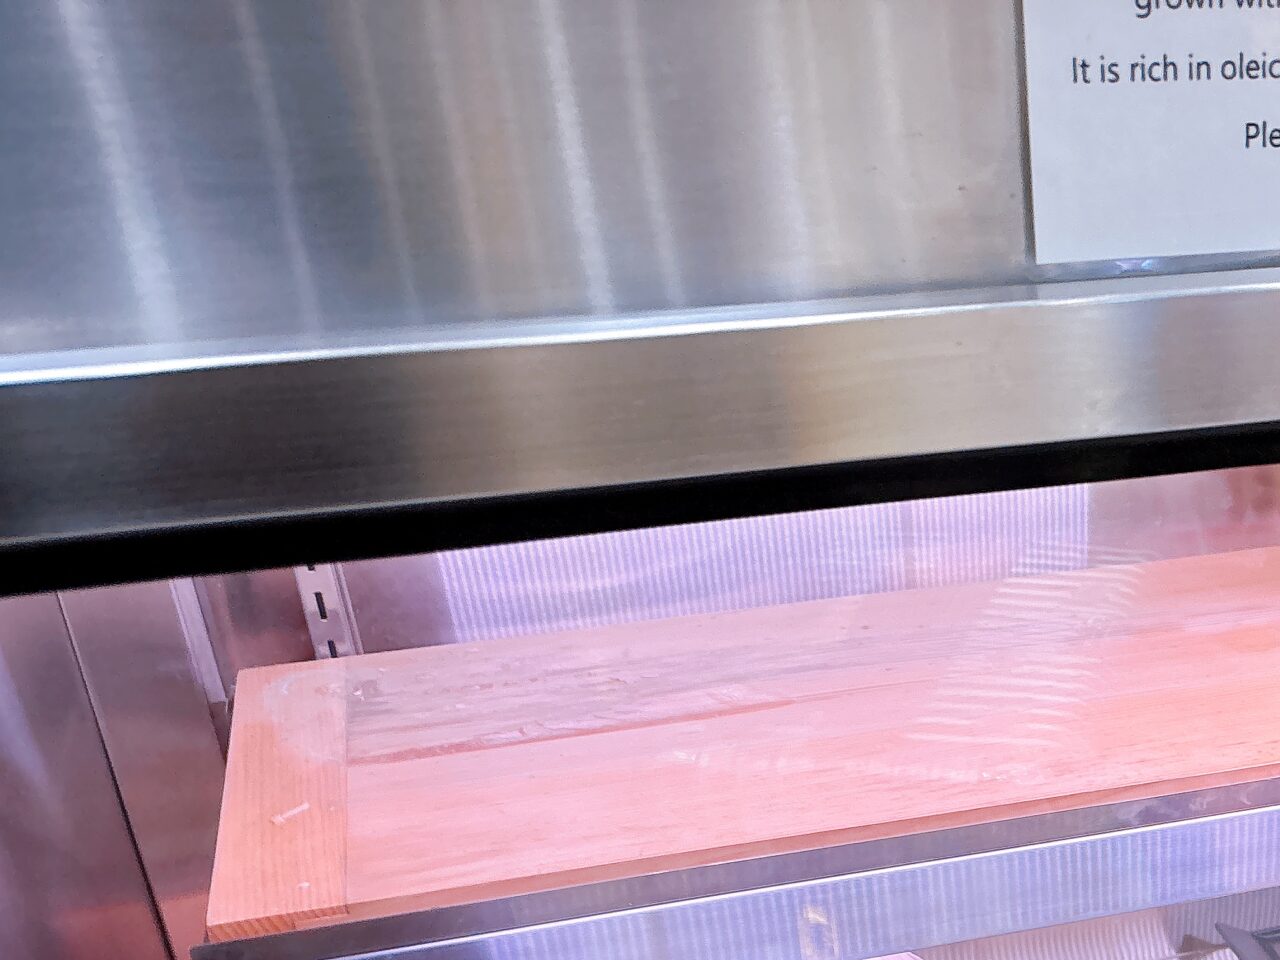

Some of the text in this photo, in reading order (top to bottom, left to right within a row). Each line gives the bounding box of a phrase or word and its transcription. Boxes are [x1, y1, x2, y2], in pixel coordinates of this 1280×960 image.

[1072, 56, 1091, 85] It
[1099, 54, 1121, 84] is
[1129, 53, 1179, 83] rich
[1187, 52, 1212, 81] in
